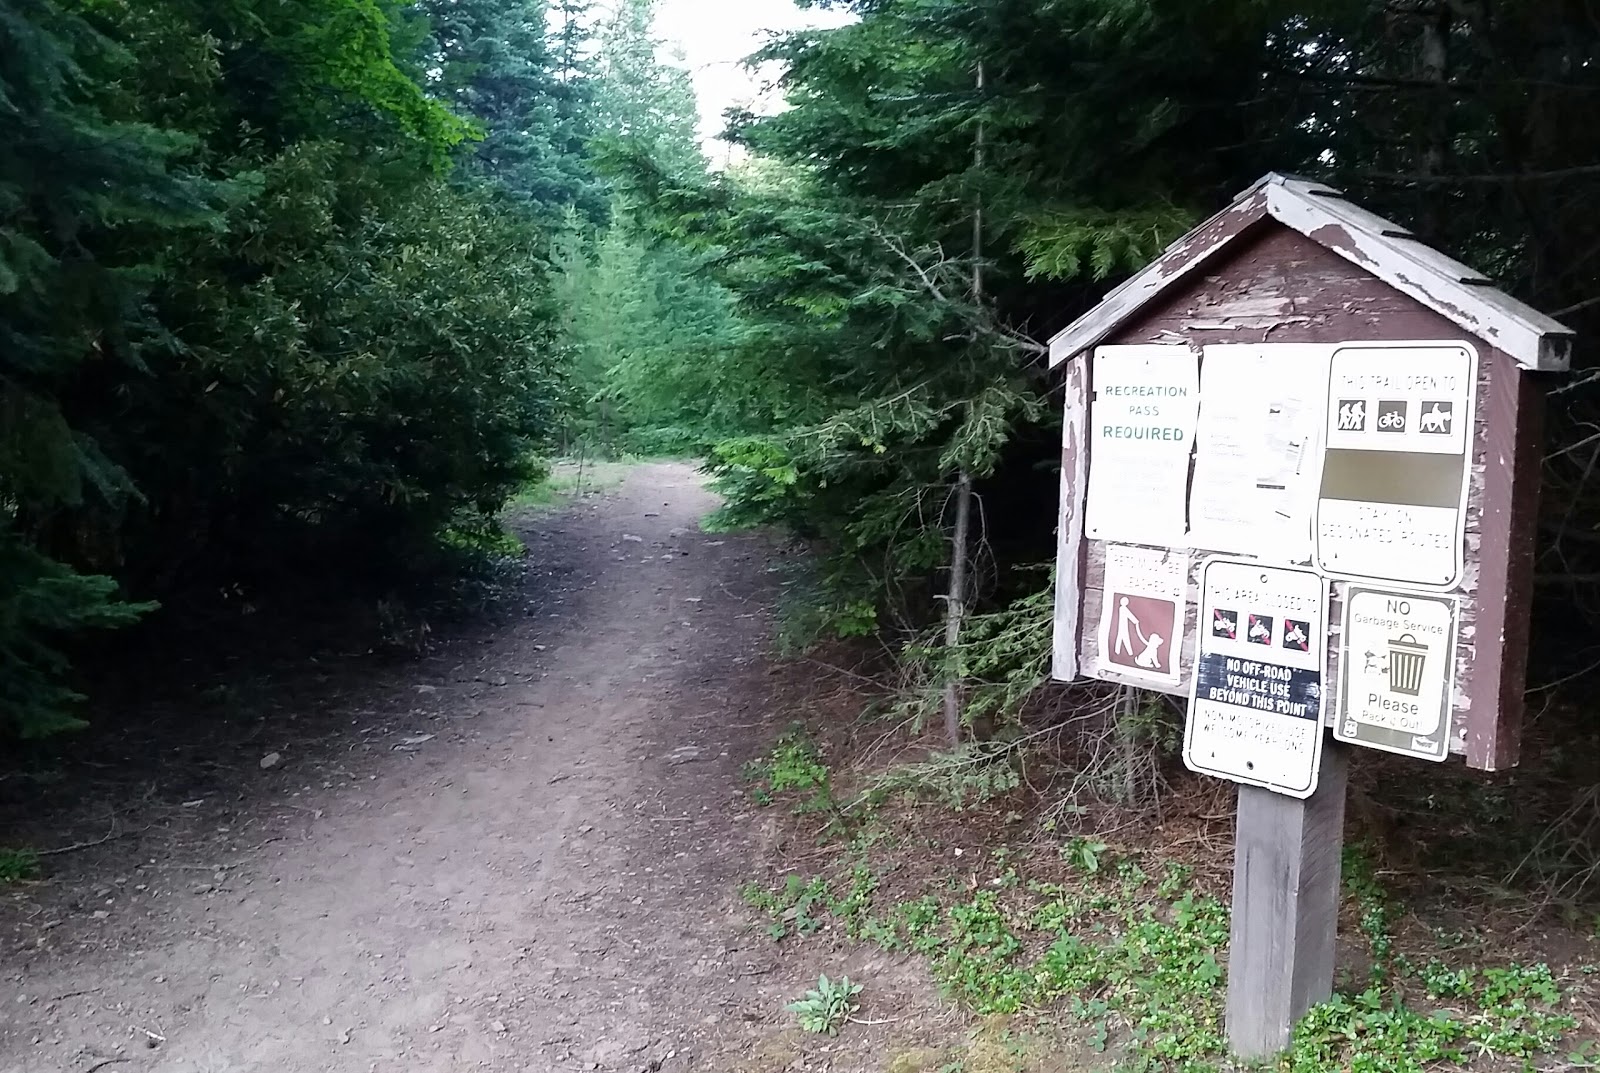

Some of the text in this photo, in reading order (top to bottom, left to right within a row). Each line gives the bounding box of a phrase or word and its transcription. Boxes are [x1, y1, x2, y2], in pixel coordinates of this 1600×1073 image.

[1105, 386, 1188, 397] RECREATION
[1129, 405, 1160, 416] PASS
[1103, 426, 1184, 441] REQUIRED
[1387, 600, 1411, 616] NO
[1354, 613, 1444, 635] Garbage Service
[1227, 658, 1292, 681] NO OFF-ROAD
[1226, 674, 1291, 698] VEHICLE USE
[1209, 687, 1307, 717] BEYOND THIS POINT
[1368, 693, 1419, 715] Please
[1362, 710, 1386, 722] Pack
